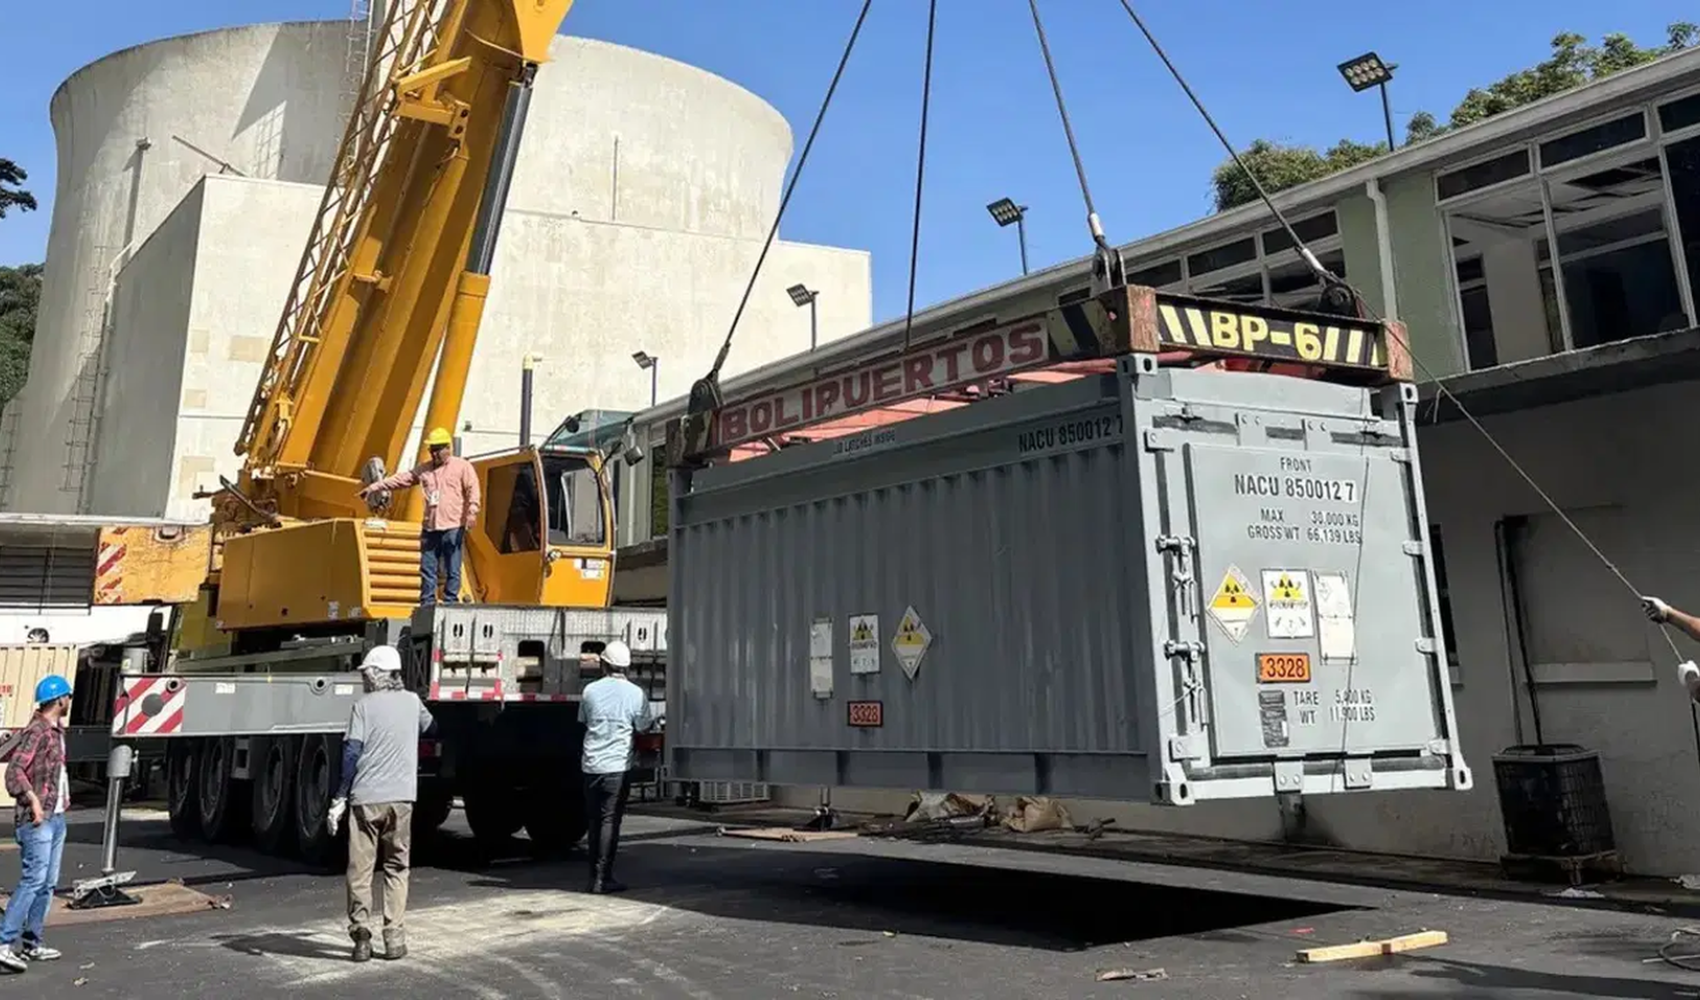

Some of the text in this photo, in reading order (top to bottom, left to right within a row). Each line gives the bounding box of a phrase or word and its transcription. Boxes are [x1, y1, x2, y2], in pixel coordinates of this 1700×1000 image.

[1210, 311, 1323, 361] BP-6
[720, 322, 1044, 443] BOLIPUERTOS
[1018, 427, 1054, 452] NACU
[1058, 416, 1112, 445] 850012
[1280, 457, 1312, 473] FRONT
[1234, 474, 1354, 502] NACU 850012 7
[1261, 508, 1284, 522] MAX
[1346, 513, 1359, 527] KG
[1247, 524, 1282, 540] GROSS
[1284, 526, 1300, 540] WT
[1343, 529, 1362, 545] LBS
[1266, 657, 1305, 678] 3328
[1293, 690, 1319, 706] TARE
[1360, 689, 1372, 705] KG
[852, 704, 879, 723] 3328
[1299, 710, 1315, 724] WT
[1359, 707, 1376, 722] LBS
